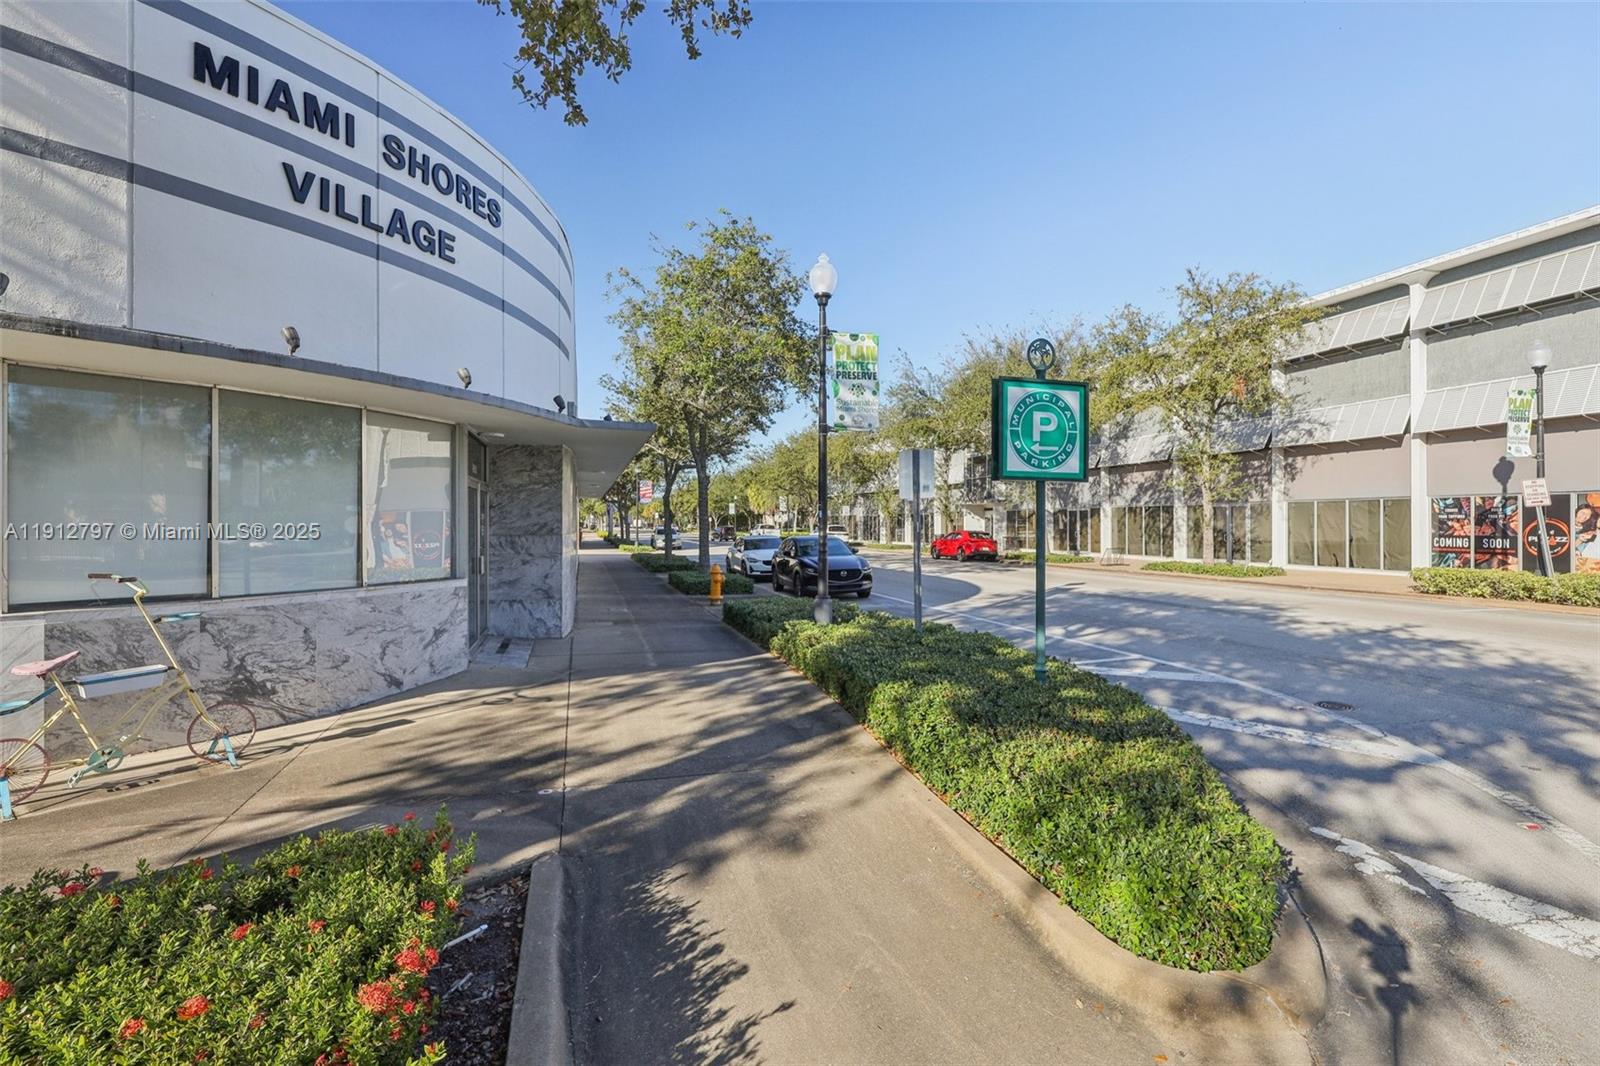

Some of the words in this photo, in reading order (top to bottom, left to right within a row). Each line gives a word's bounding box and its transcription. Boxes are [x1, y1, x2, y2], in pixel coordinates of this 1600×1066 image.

[193, 42, 355, 148] MIAMI
[382, 134, 502, 228] SHORES
[282, 162, 457, 264] VILLAGE
[834, 343, 878, 361] PLAN
[836, 361, 877, 372] PROTECT
[836, 371, 878, 381] PRESERVE
[1012, 393, 1077, 429] MUNICIPAL
[1507, 397, 1532, 409] PLAN
[1032, 411, 1059, 442] P
[1013, 442, 1074, 468] PARKING
[1433, 537, 1469, 548] COMING
[1482, 538, 1510, 549] SOON
